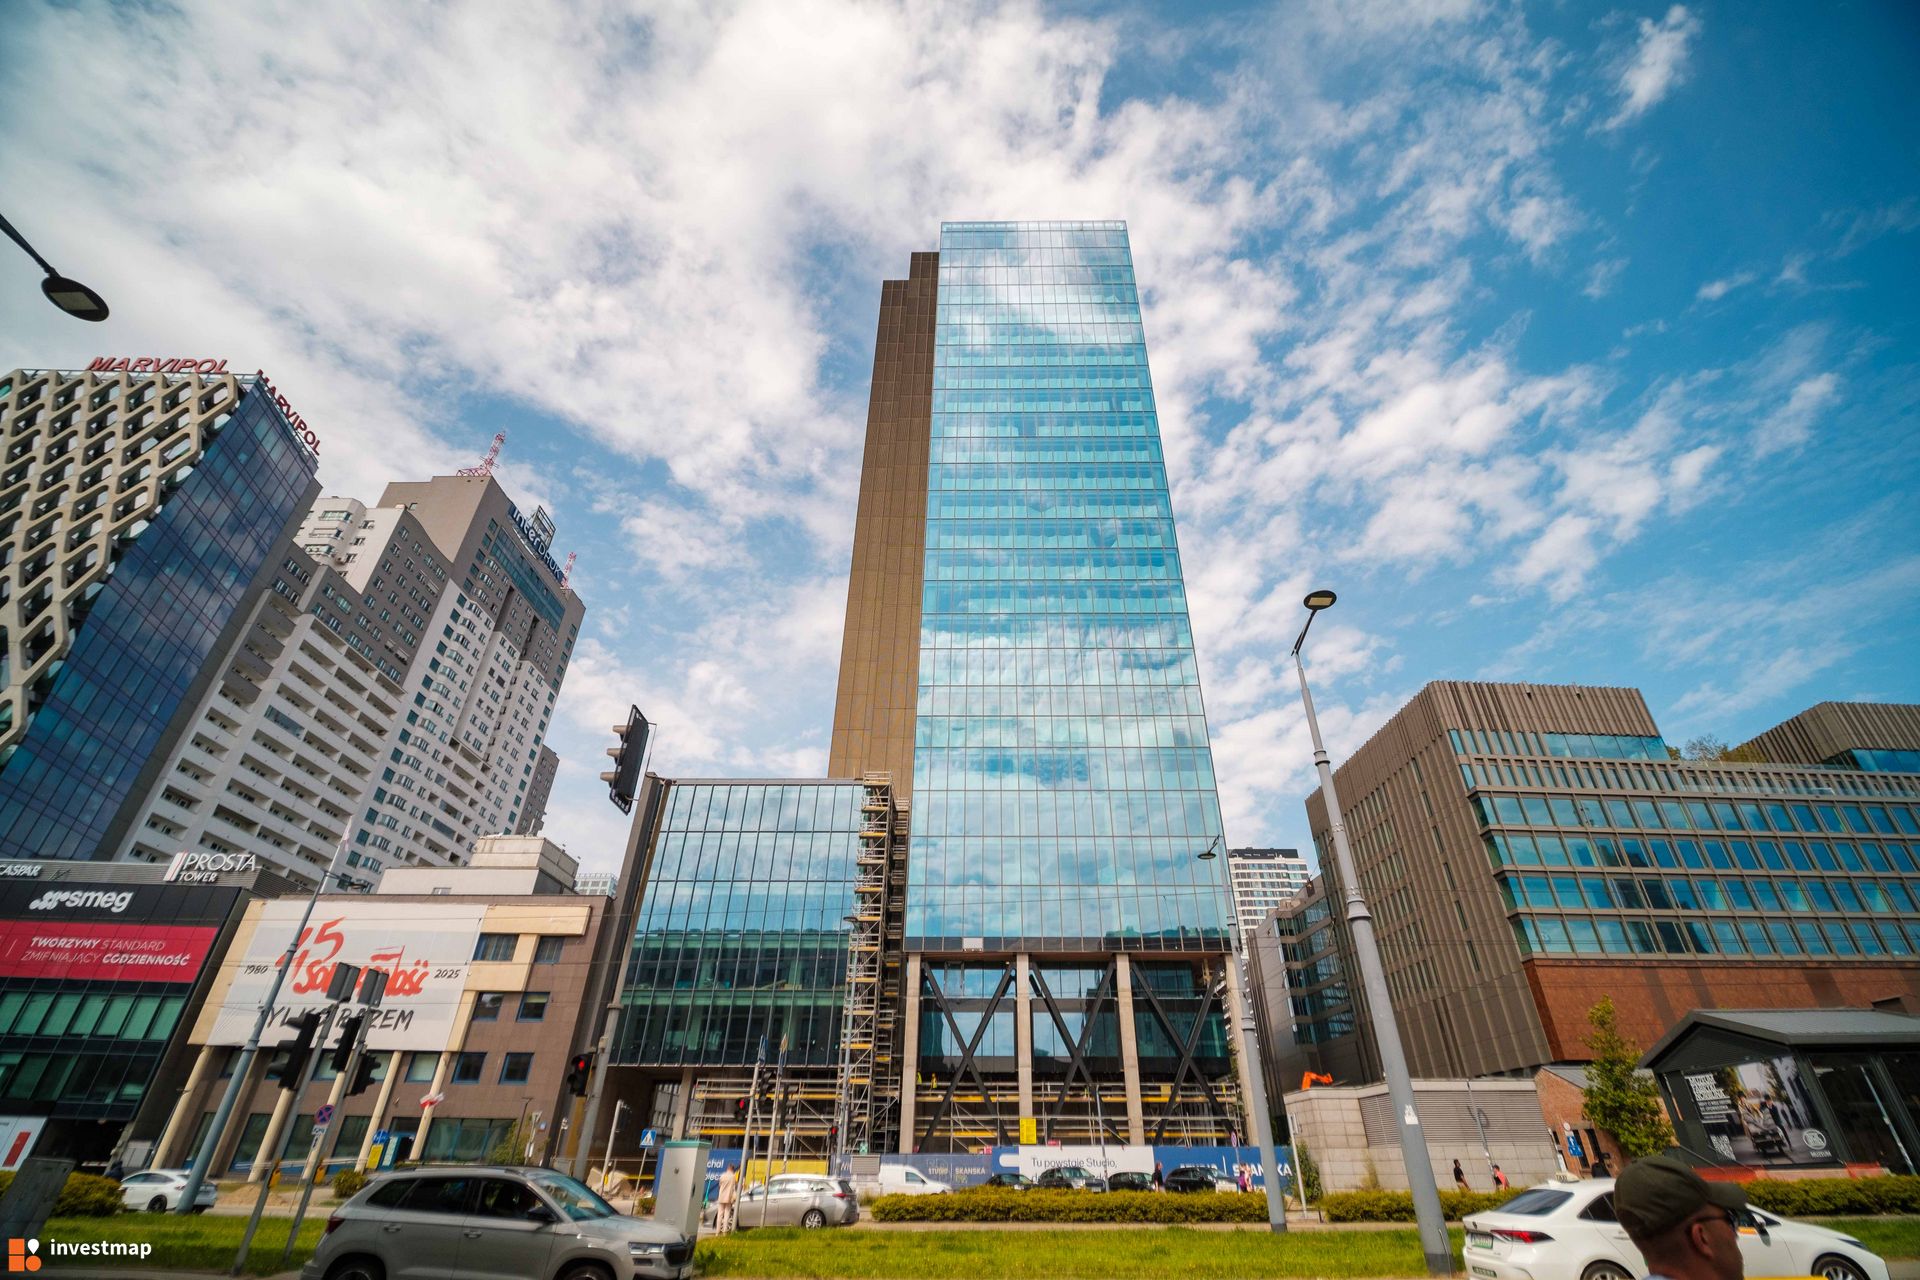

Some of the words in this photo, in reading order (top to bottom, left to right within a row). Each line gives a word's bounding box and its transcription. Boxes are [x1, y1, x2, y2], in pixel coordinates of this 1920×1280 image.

[86, 357, 229, 374] MARVIPOL
[183, 853, 256, 871] PROSTA
[178, 871, 218, 882] TOWER
[65, 890, 134, 913] smeg
[31, 937, 100, 949] TWORZYMY
[101, 939, 166, 952] STANDARD
[244, 964, 268, 975] 1980
[433, 968, 461, 979] 2025
[1032, 1157, 1042, 1167] Tu
[955, 1166, 986, 1175] SKANSKA
